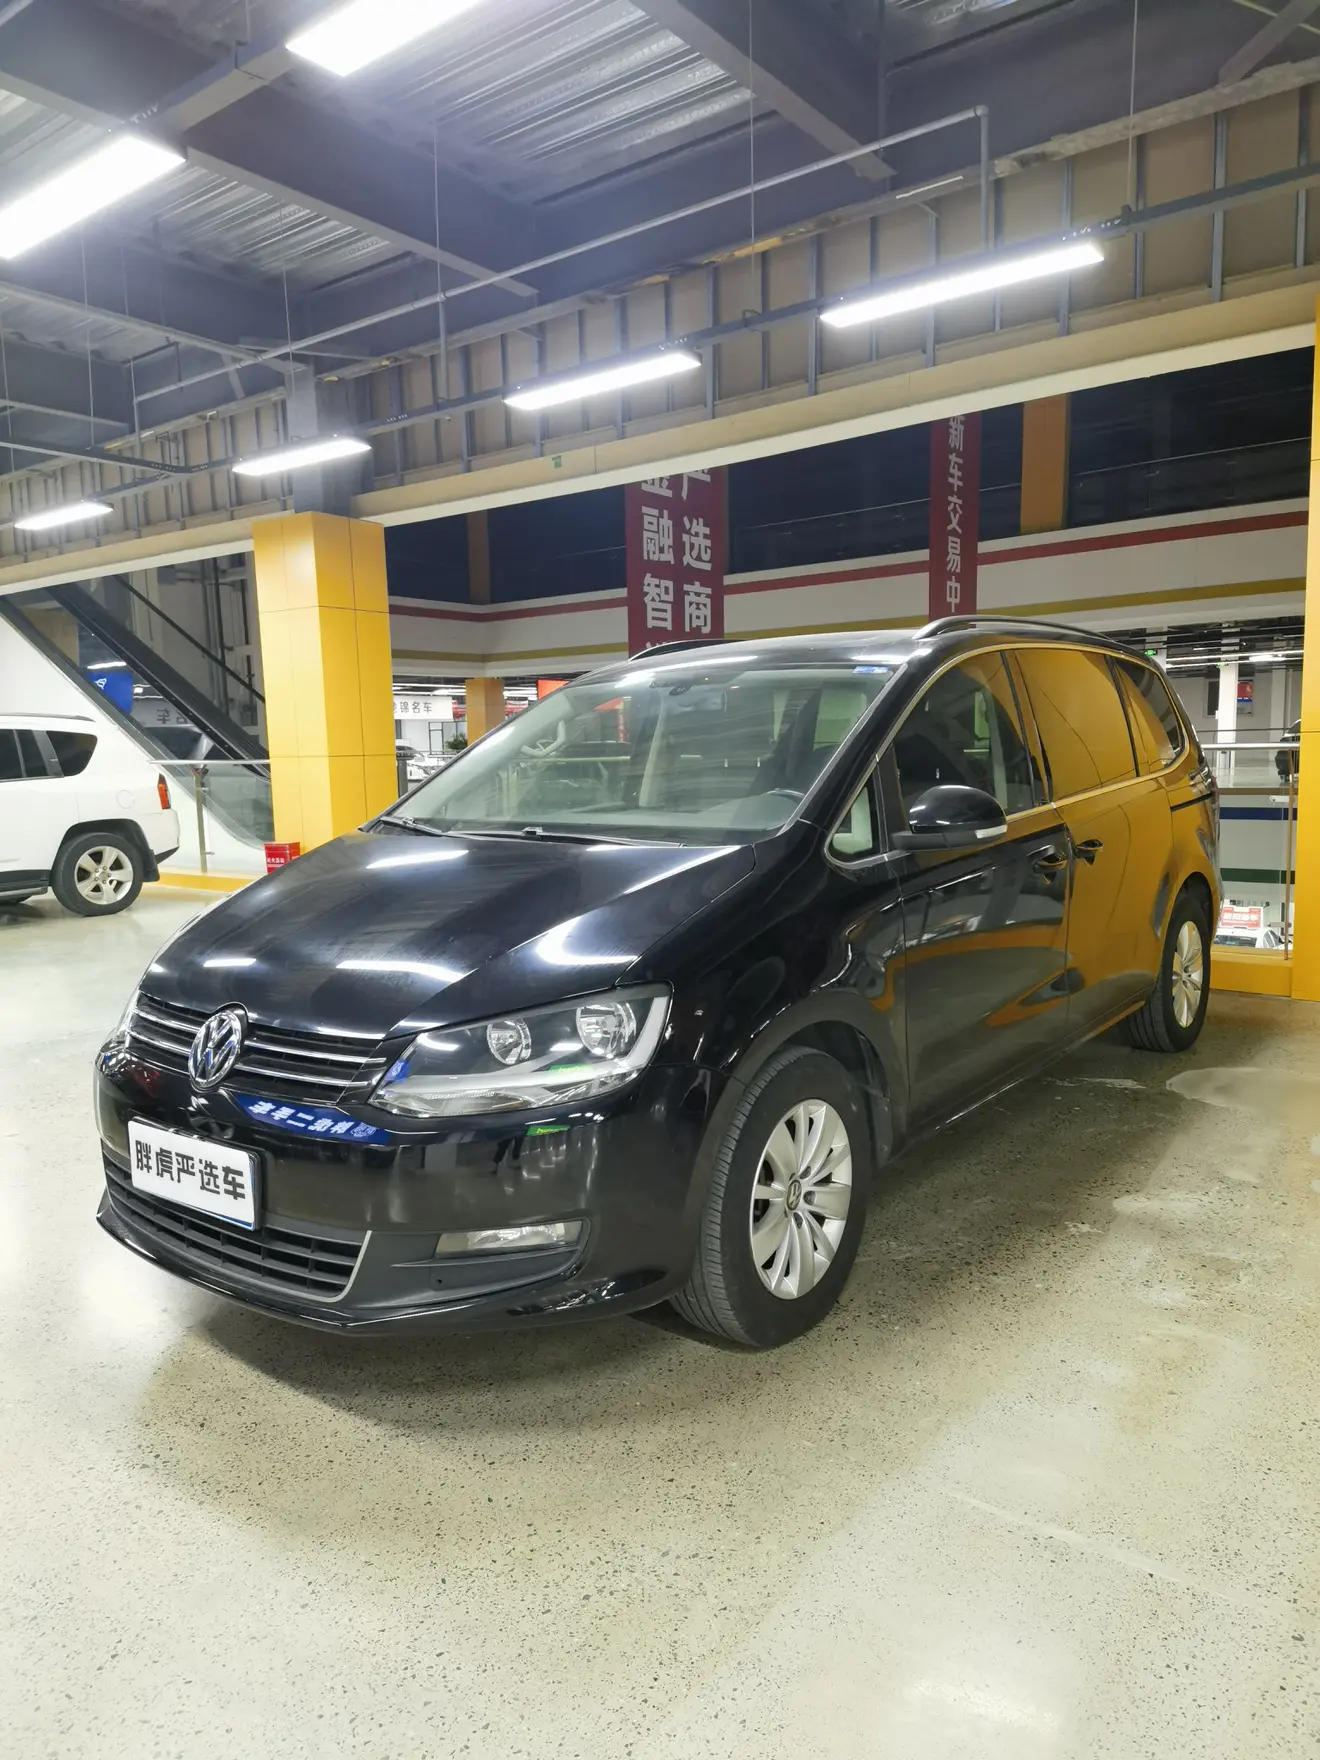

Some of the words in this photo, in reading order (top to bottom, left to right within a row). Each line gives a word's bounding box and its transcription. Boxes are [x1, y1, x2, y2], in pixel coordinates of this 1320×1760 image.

[135, 1140, 246, 1200] 胖虎严选车
